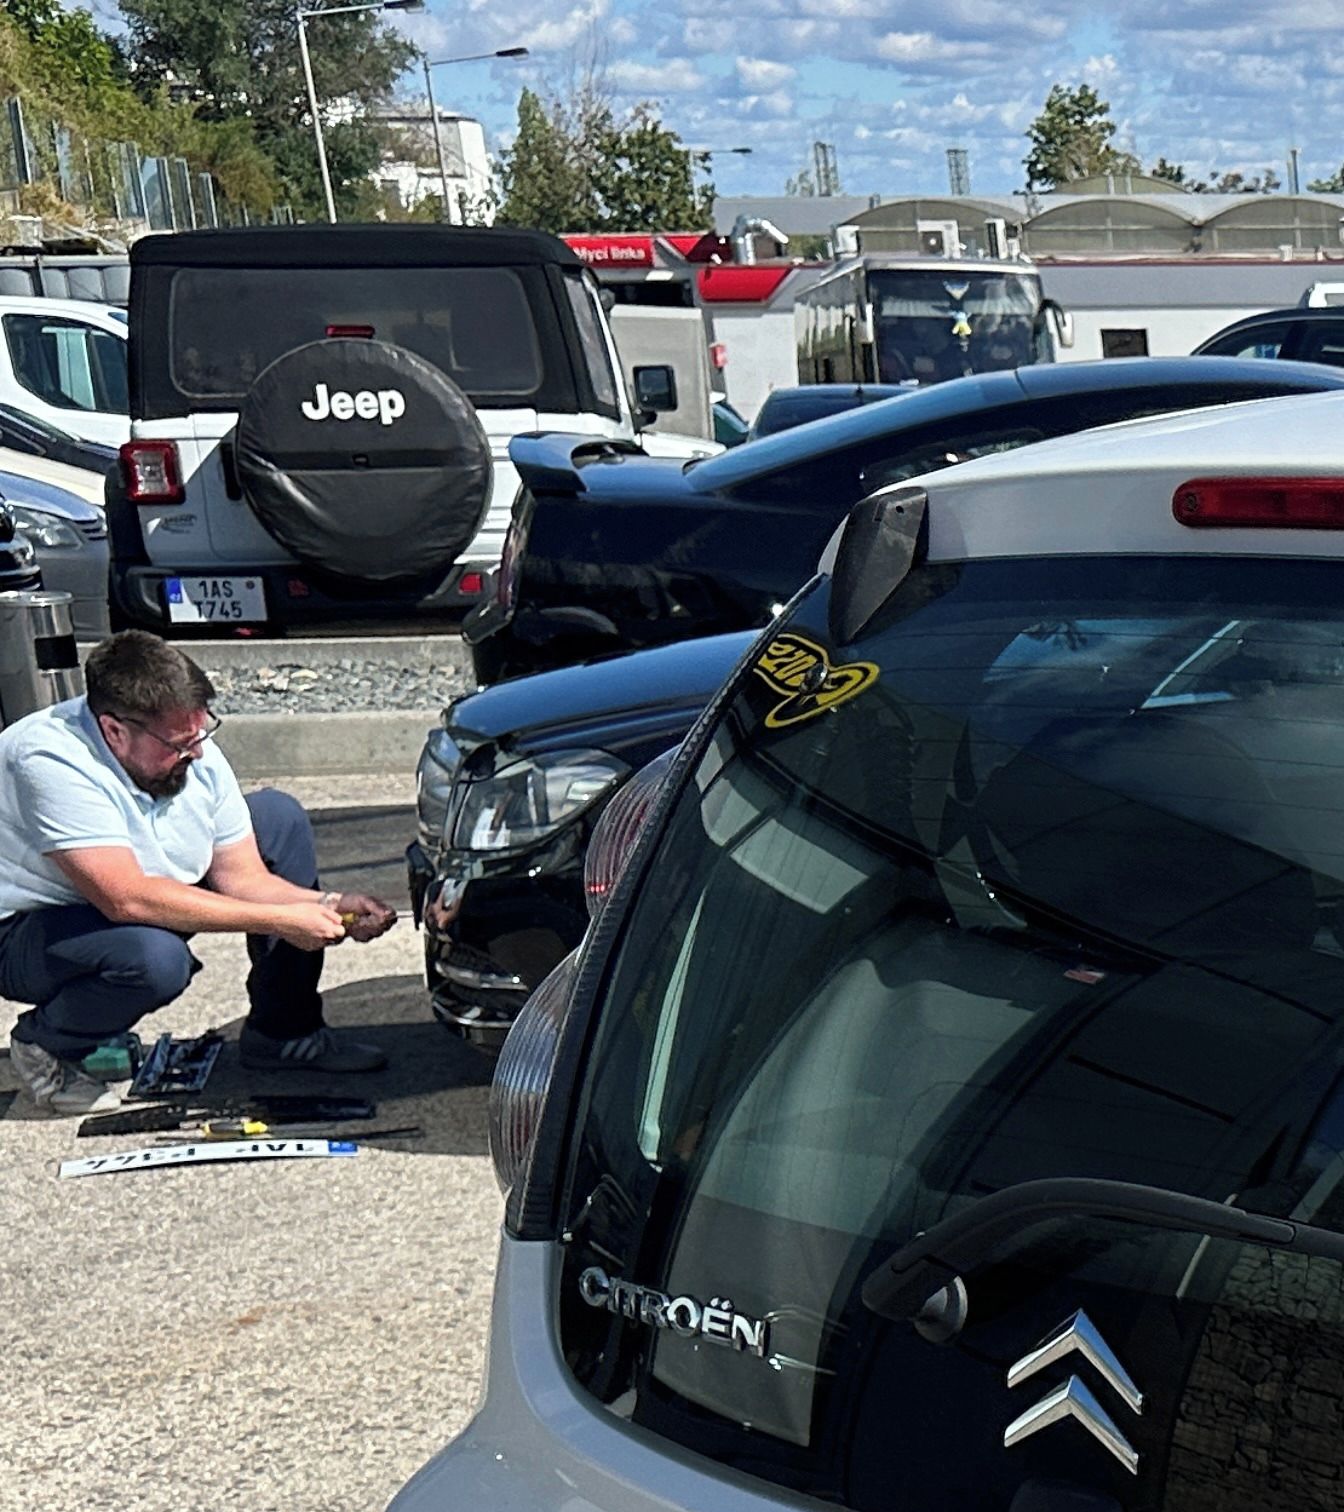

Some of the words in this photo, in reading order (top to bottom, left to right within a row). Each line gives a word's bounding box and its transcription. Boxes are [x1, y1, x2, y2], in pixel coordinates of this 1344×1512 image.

[301, 384, 406, 425] Jeep
[199, 580, 234, 599] 1AS
[579, 1266, 765, 1358] CITROËN
